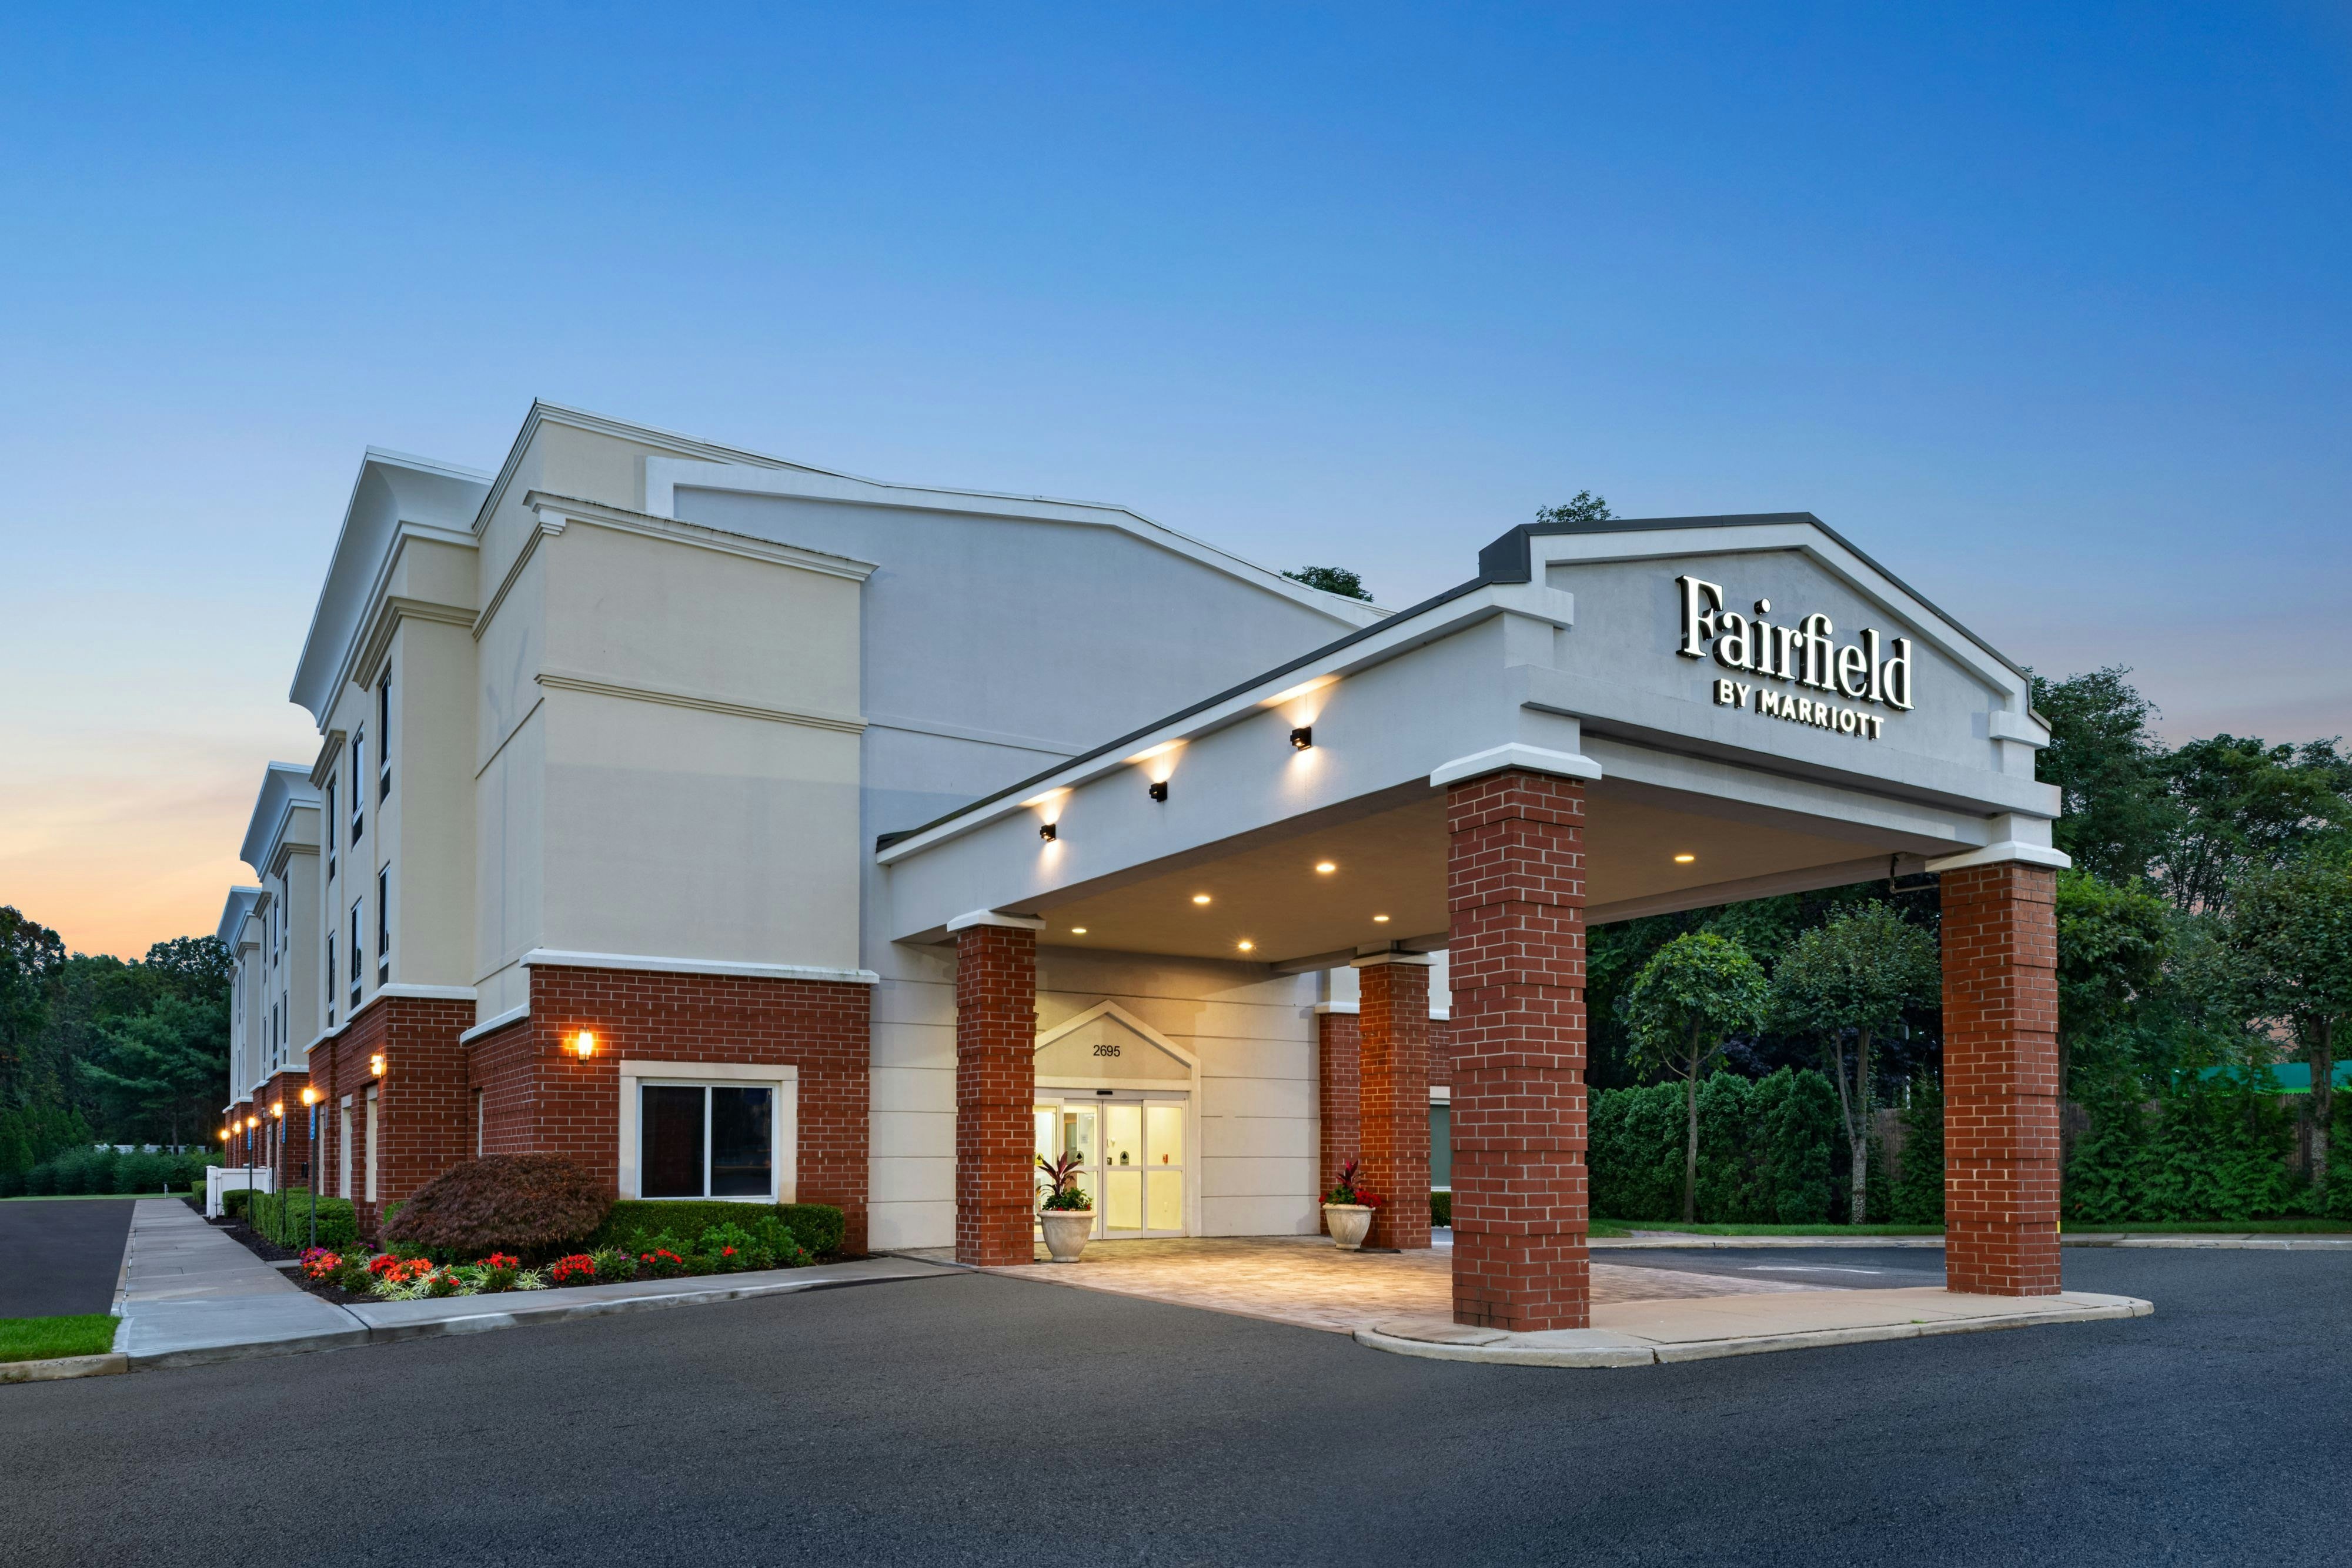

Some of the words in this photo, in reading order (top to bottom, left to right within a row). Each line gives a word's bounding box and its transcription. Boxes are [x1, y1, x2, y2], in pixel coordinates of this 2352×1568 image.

[1677, 575, 1915, 710] Fairfield
[1716, 678, 1750, 708] BY
[1758, 688, 1884, 740] MARRIOTT
[1093, 1045, 1120, 1057] 2695
